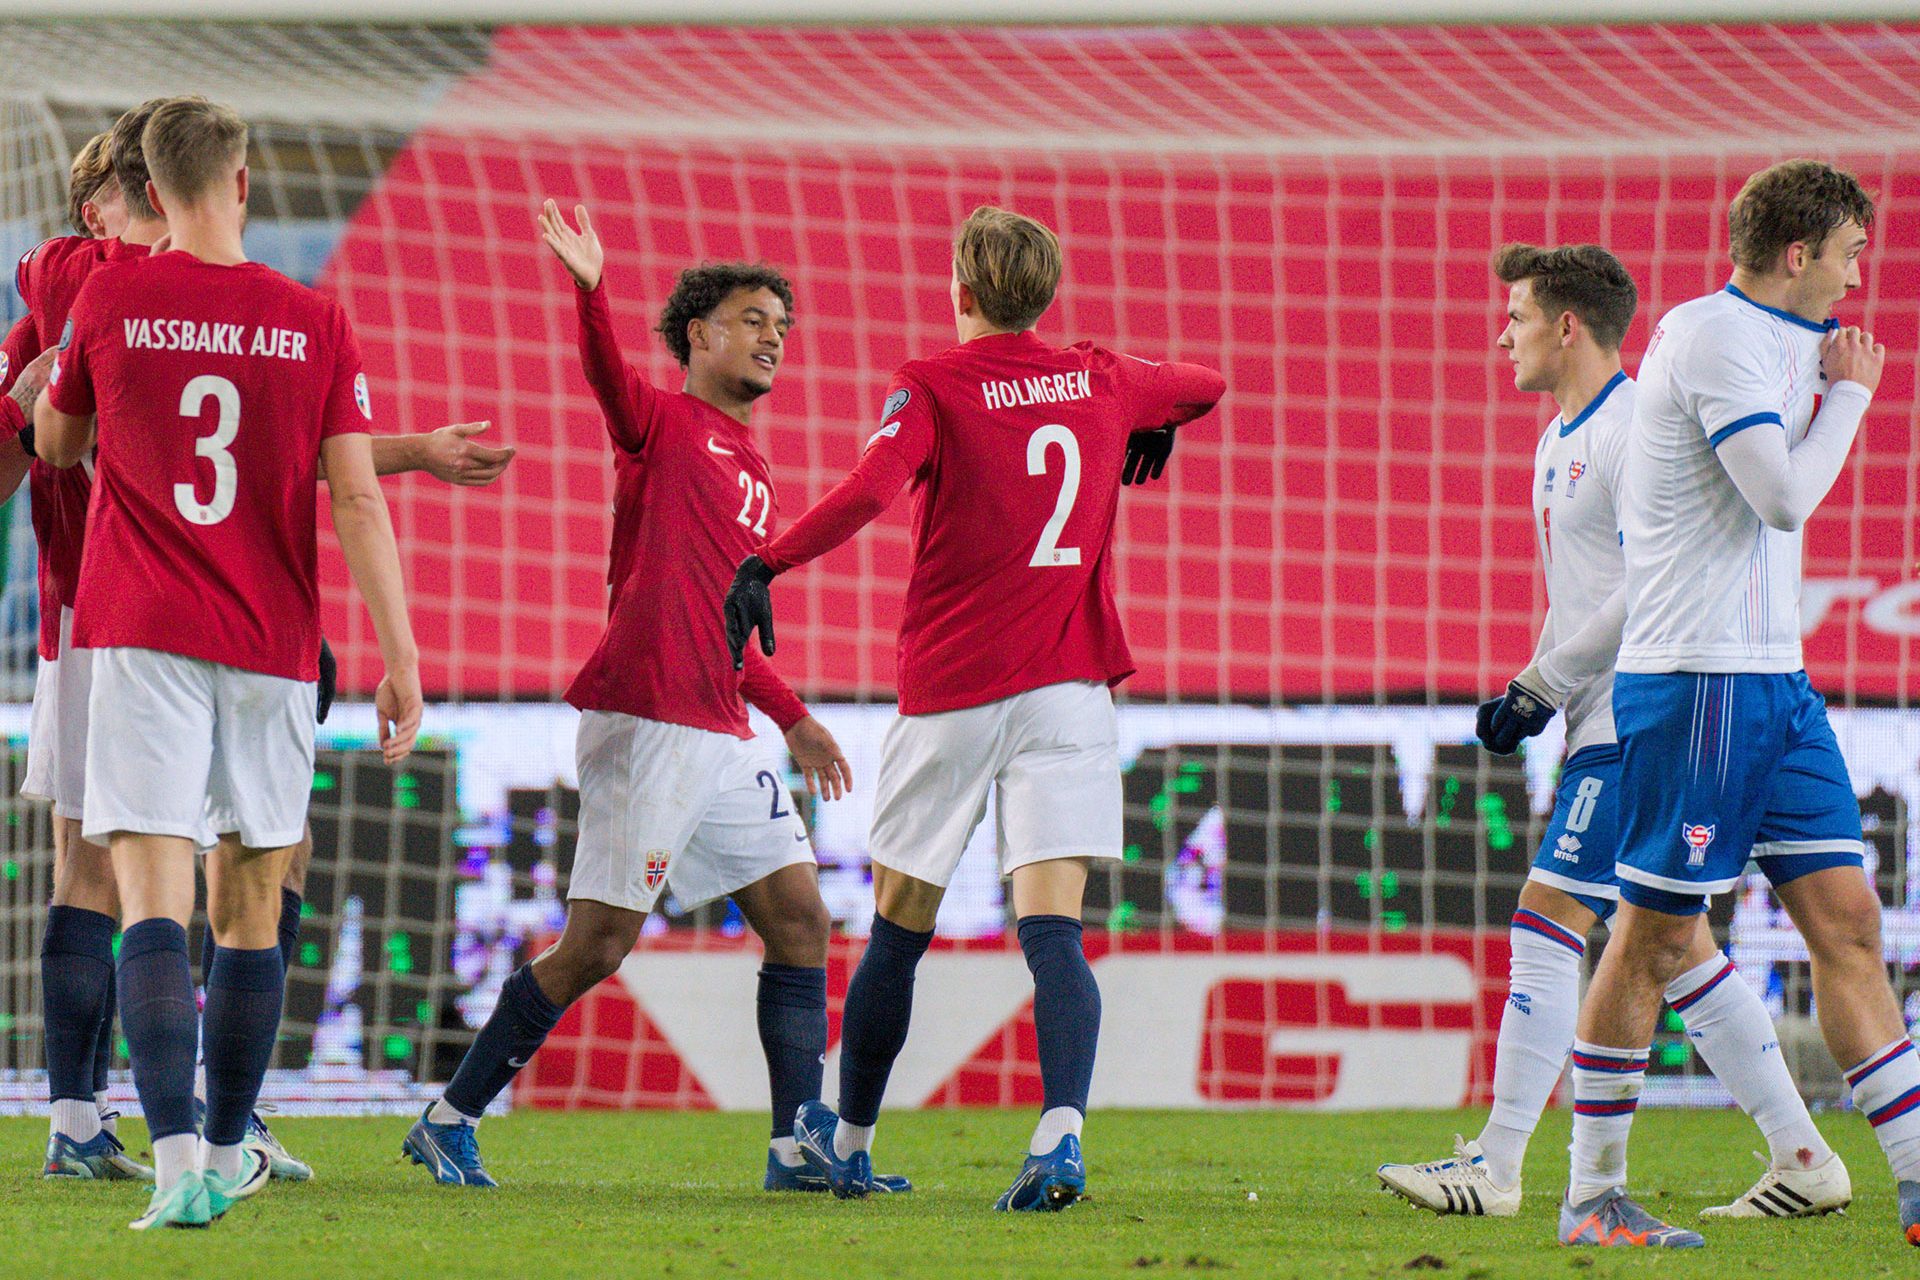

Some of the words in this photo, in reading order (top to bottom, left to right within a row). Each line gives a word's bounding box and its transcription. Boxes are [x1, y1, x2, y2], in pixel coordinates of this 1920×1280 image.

[123, 318, 245, 355] VASSBAKK
[250, 325, 307, 361] AJER
[981, 369, 1092, 410] HOLMGREN
[173, 374, 242, 525] 3
[736, 470, 770, 539] 22
[1026, 423, 1082, 567] 2
[755, 769, 790, 820] 2
[1565, 775, 1604, 833] 8
